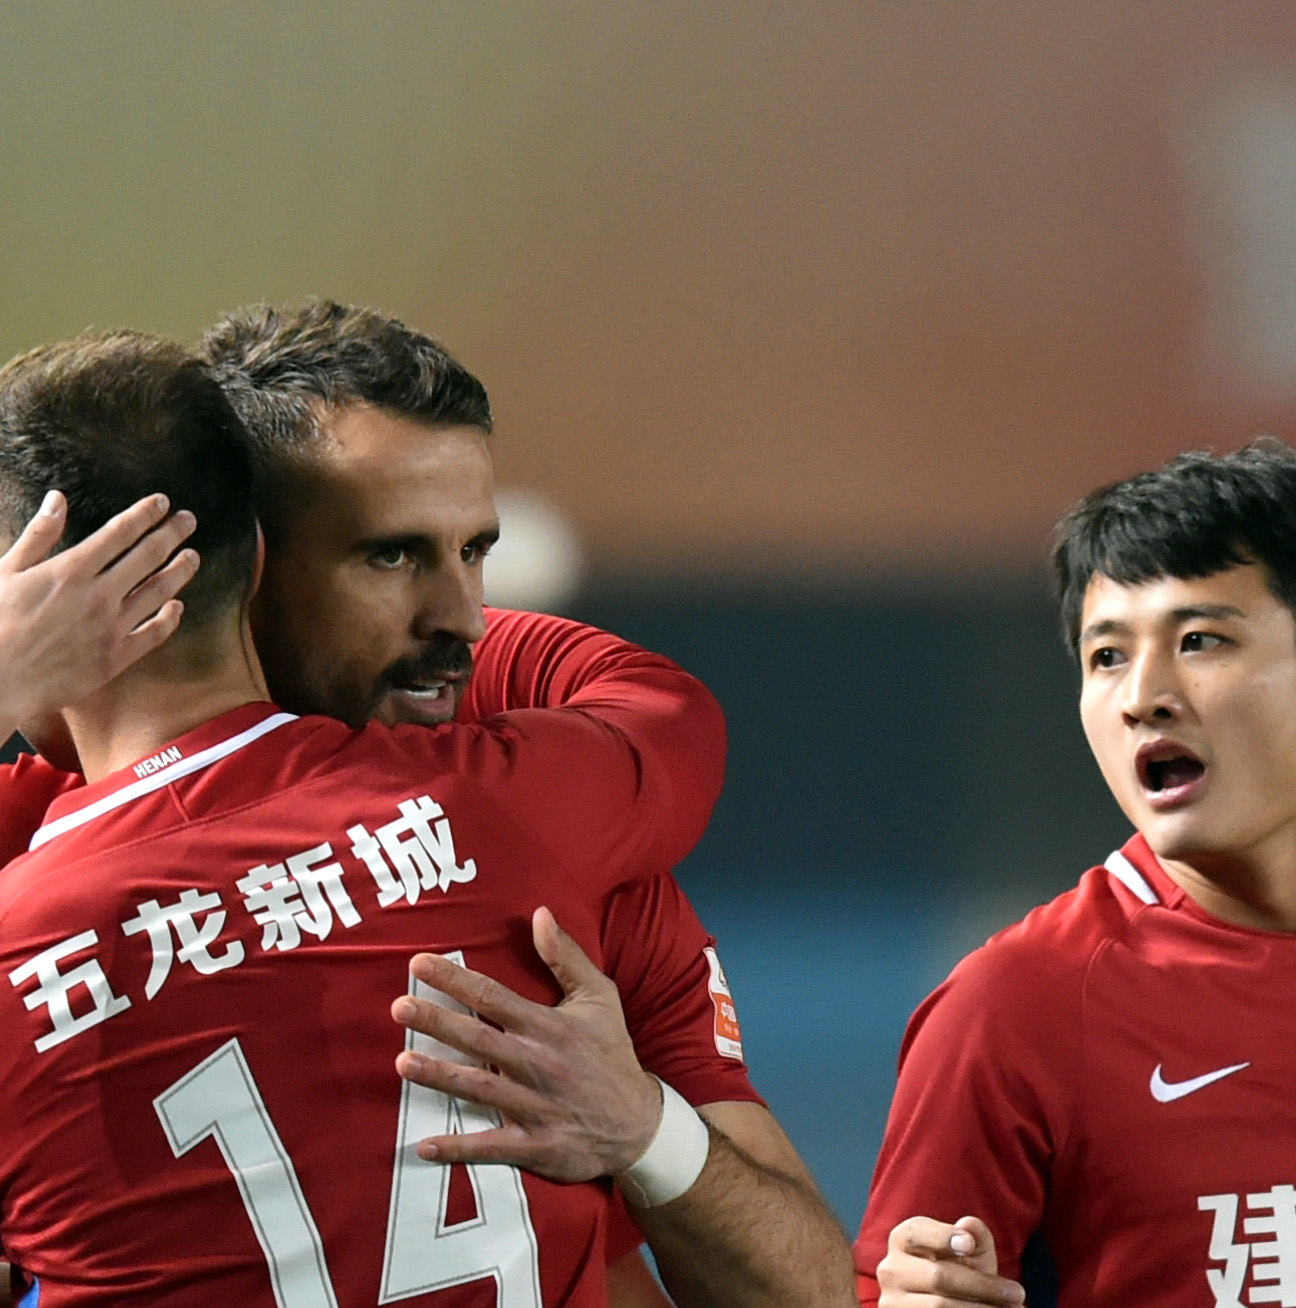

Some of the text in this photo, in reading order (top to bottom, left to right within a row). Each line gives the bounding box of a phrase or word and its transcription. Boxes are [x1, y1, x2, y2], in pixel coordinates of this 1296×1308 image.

[132, 745, 183, 779] HENAN
[8, 795, 478, 1054] 五龙新城
